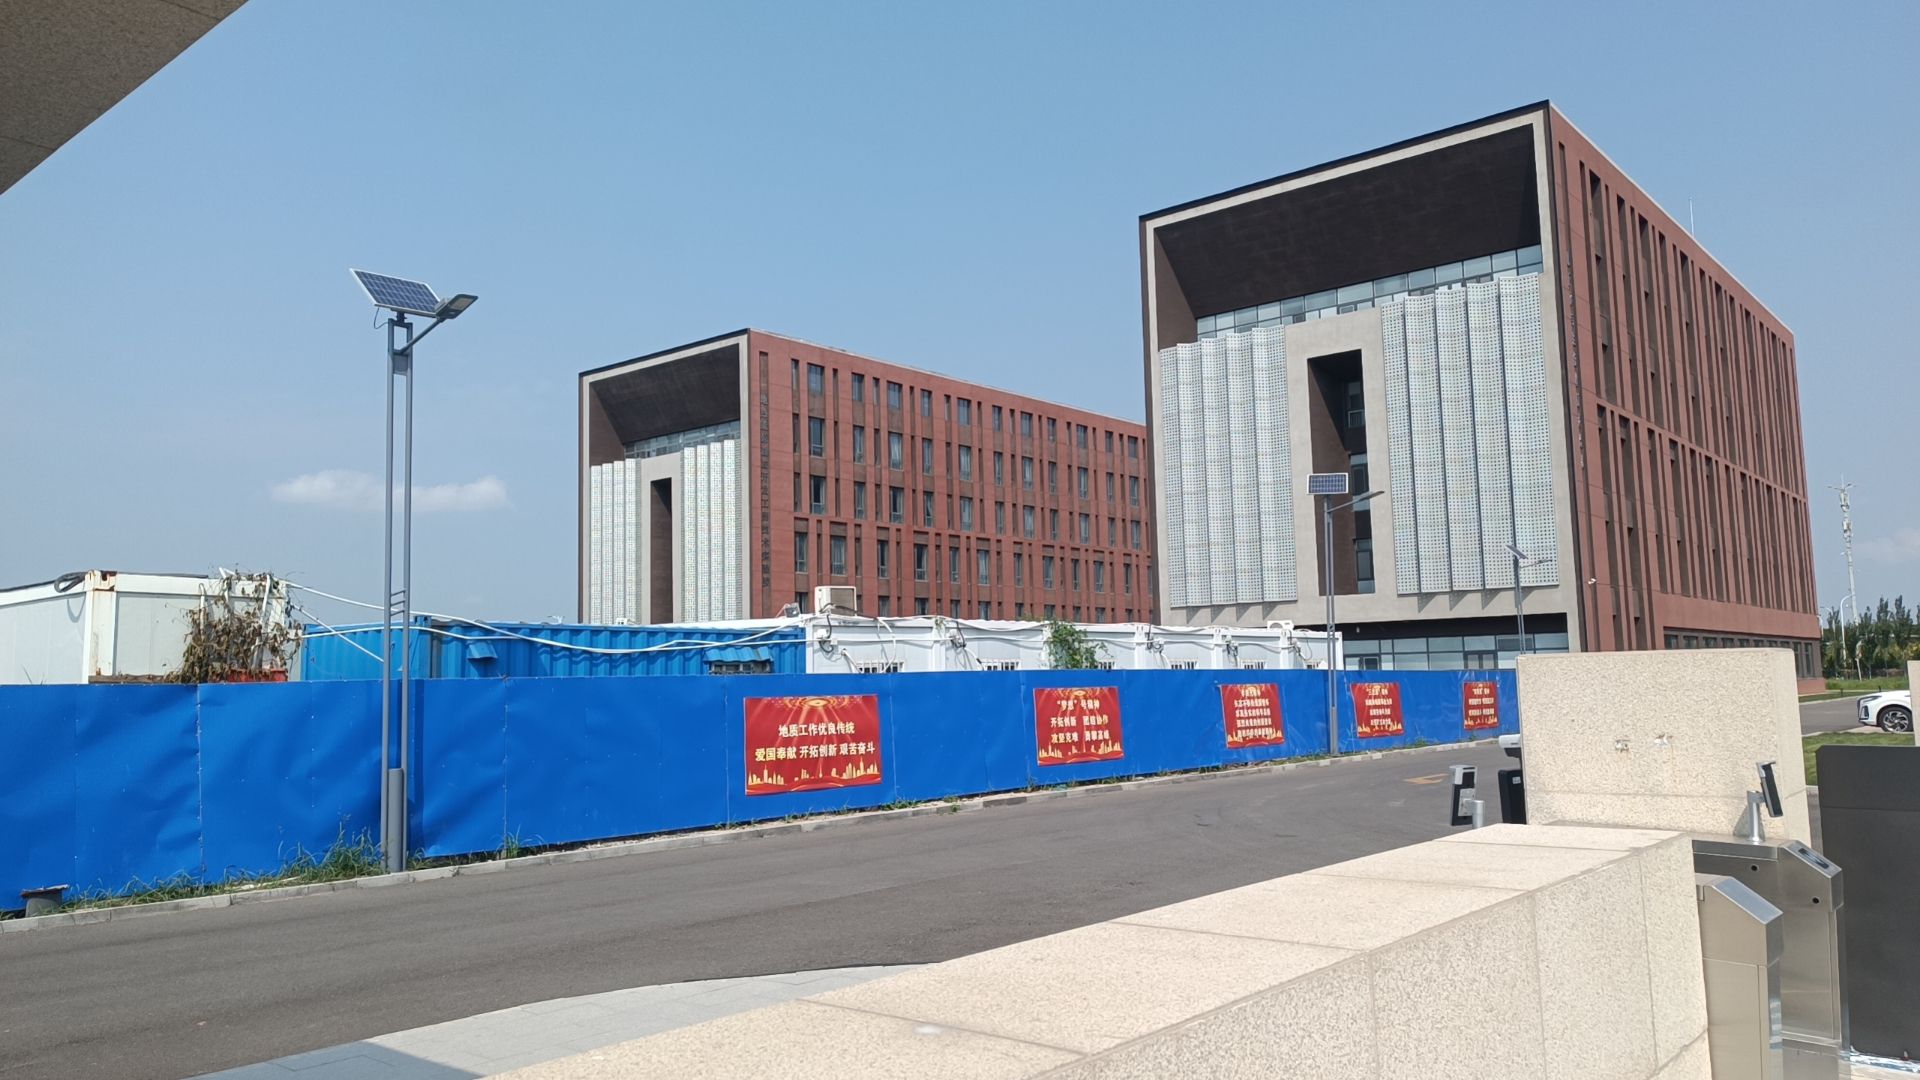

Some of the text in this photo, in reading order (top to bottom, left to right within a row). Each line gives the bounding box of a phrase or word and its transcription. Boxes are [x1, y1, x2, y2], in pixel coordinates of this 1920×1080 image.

[778, 722, 855, 737] 地质工作优良传统
[1050, 716, 1077, 728] 开拓创新
[755, 741, 876, 762] 爱国奉献 开拓创新 艰苦奋斗
